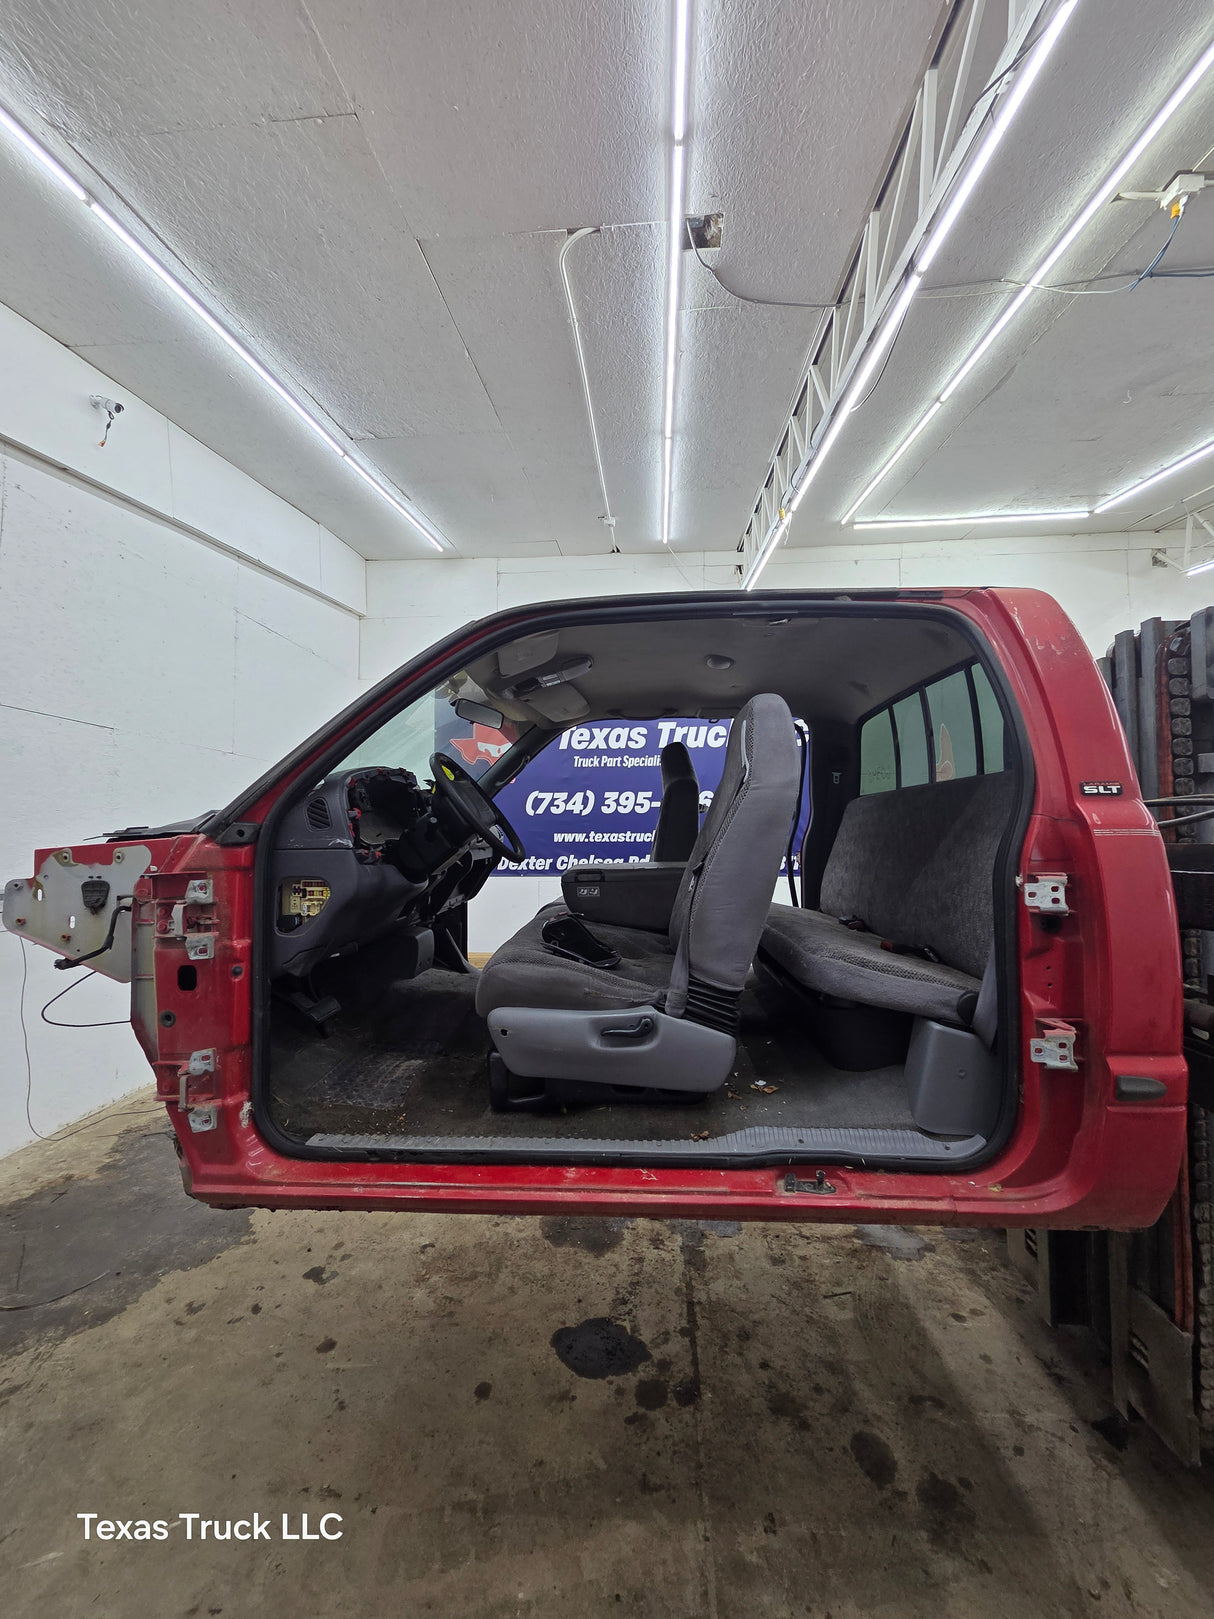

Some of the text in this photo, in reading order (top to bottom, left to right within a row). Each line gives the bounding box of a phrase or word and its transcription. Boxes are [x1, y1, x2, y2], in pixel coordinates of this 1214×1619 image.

[559, 726, 648, 750] Texas
[573, 754, 662, 768] Truck Part Speciali
[1083, 785, 1120, 794] SLT
[525, 789, 595, 816] (734)
